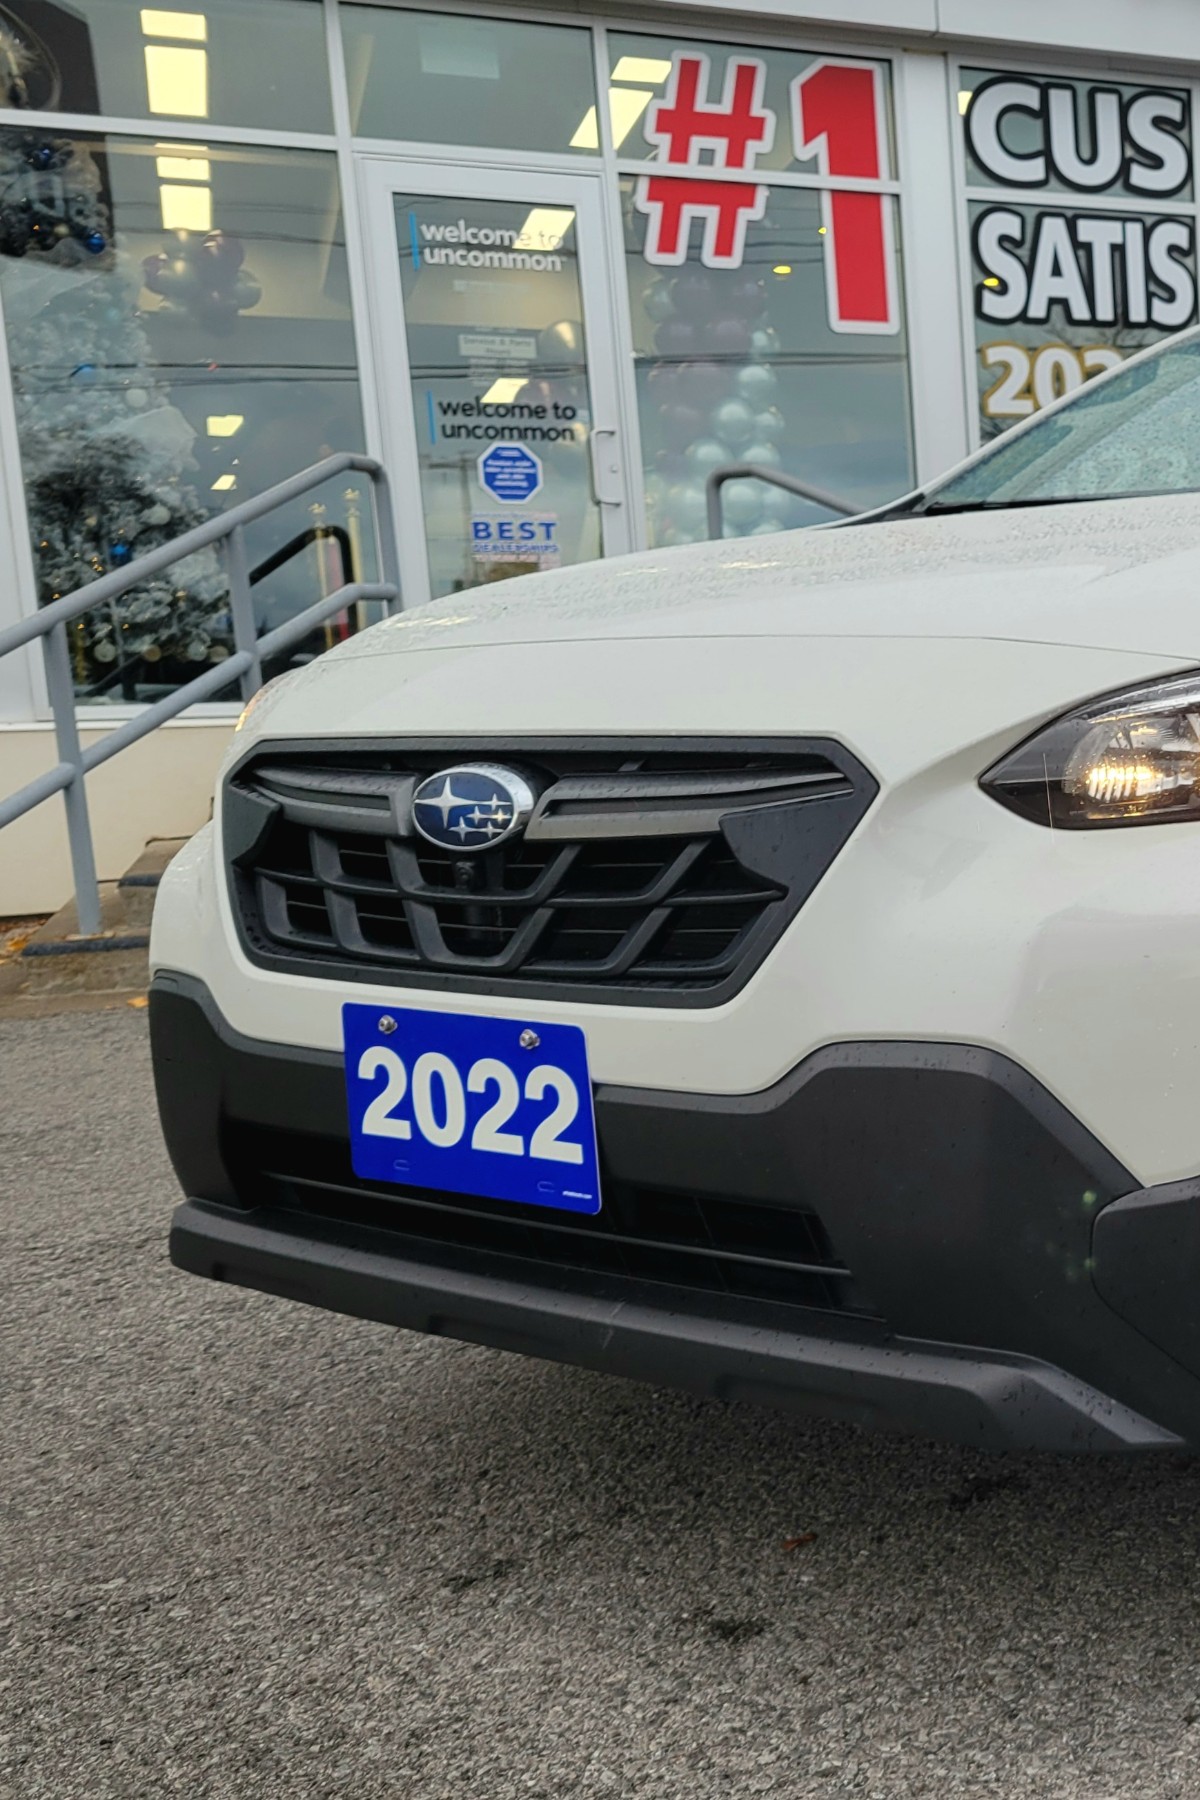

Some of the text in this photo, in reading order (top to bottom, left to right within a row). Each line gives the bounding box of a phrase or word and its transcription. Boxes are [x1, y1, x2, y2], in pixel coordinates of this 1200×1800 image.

[635, 50, 900, 336] #1
[420, 218, 532, 247] welcome
[423, 246, 562, 272] uncommon
[438, 395, 577, 420] welcome to
[441, 423, 576, 442] uncommon
[471, 521, 557, 541] BEST
[357, 1045, 585, 1166] 2022
